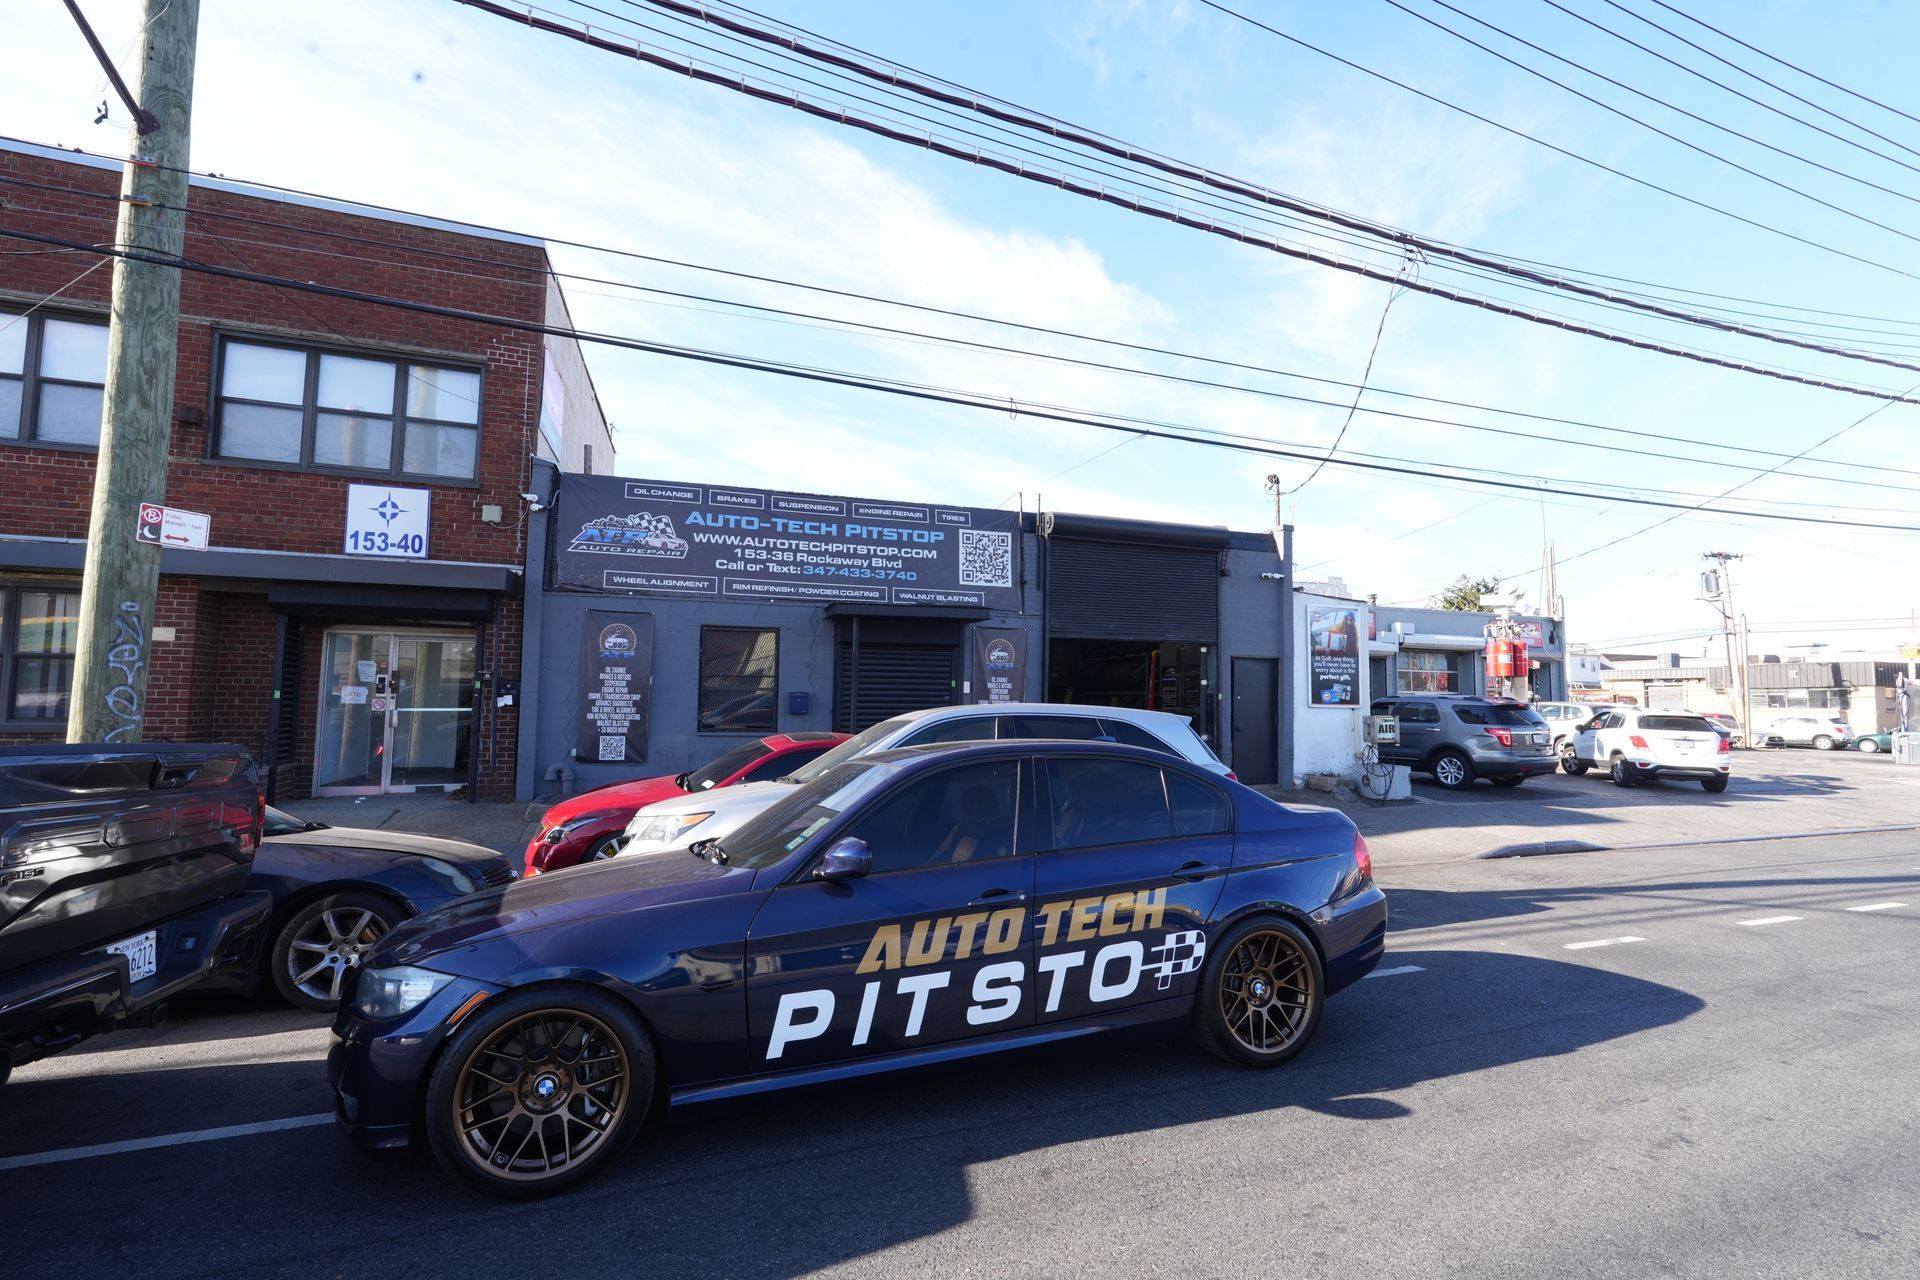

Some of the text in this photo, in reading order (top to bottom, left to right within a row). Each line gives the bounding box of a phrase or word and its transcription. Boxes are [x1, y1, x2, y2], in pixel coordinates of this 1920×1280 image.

[633, 487, 694, 499] OIL CHANGE
[716, 495, 757, 505] BRAKES
[778, 501, 839, 512] SUSPENSION
[859, 508, 924, 519] ENGINE REPAIR
[941, 513, 966, 522] TIRES
[684, 511, 945, 543] AUTO-TECH PITSTOP
[349, 530, 424, 554] 153-40
[693, 532, 938, 559] WWW.AUTOTECHPITSTOP.COM
[578, 544, 682, 557] AUTO REPAIR
[733, 548, 903, 569] 153-36 Rockaway Blvd
[715, 559, 918, 581] Call or Text: 347-433-3740
[613, 576, 709, 588] WHEEL ALIGNMENT
[732, 583, 880, 598] RIM REFINISH/ POWDER COATING
[899, 592, 978, 603] WALNUT BLASTING
[1342, 656, 1354, 664] thing
[1378, 724, 1395, 734] AIR
[854, 887, 1169, 975] AUTO TECH
[130, 940, 145, 950] YORK
[131, 943, 153, 972] 6212
